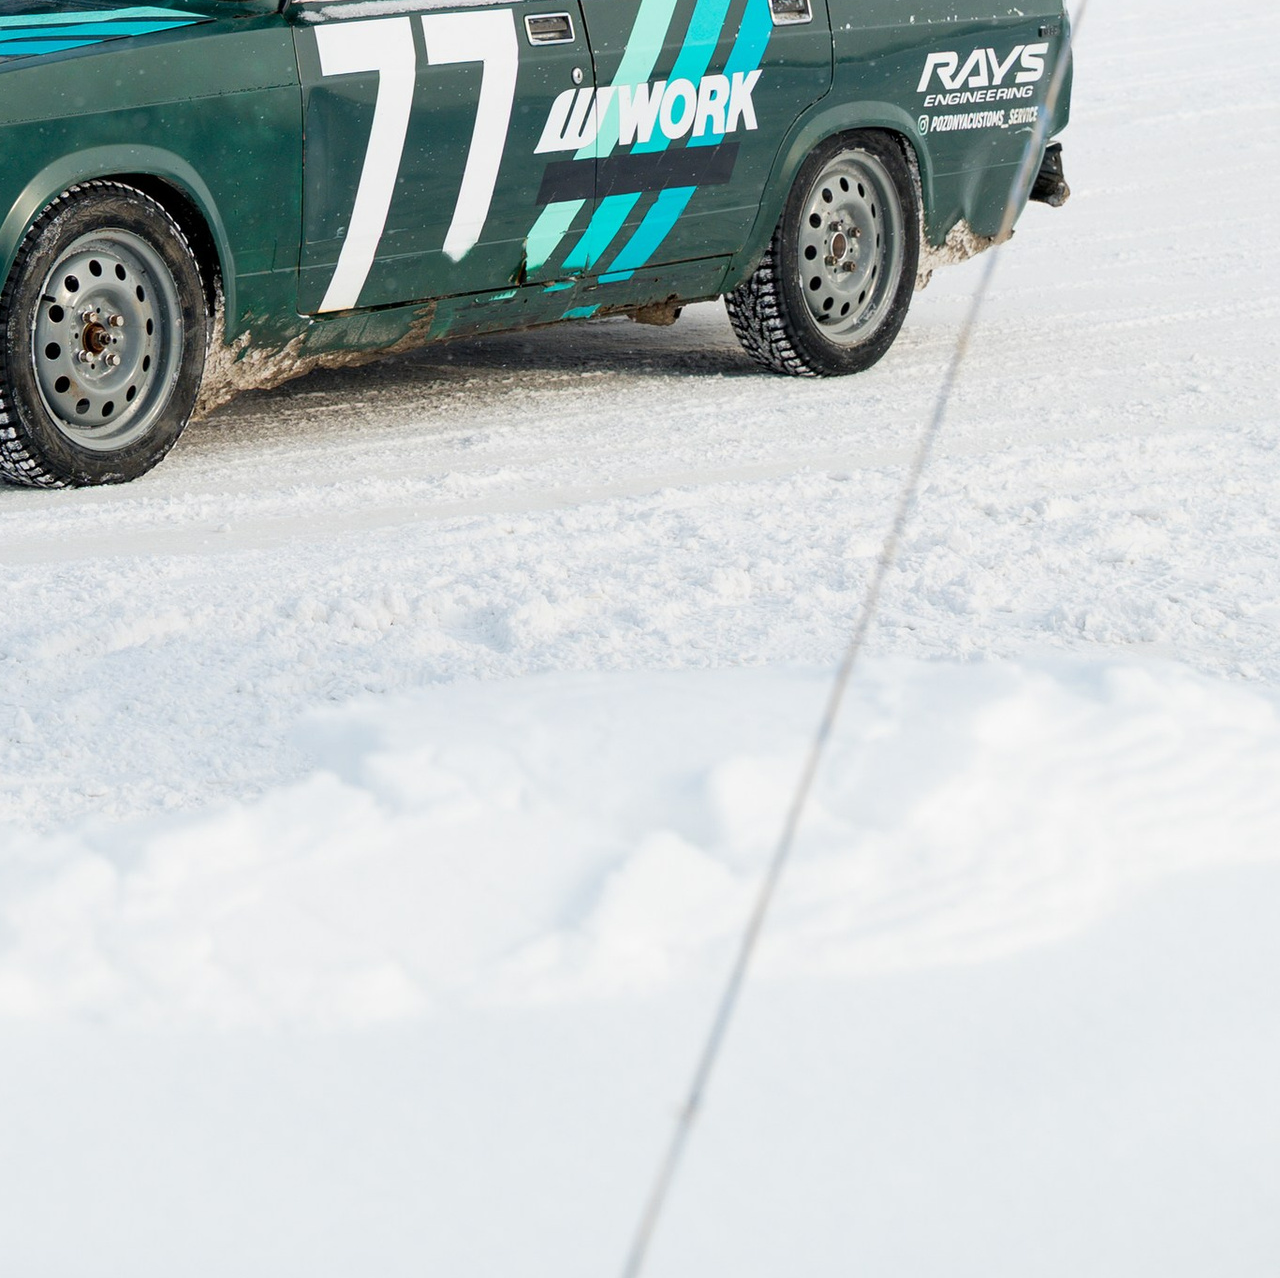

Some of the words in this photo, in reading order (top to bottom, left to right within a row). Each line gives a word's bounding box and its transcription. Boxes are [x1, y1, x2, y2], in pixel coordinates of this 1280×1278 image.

[916, 41, 1049, 93] RAYS
[923, 85, 1034, 107] ENGINEERING
[313, 7, 519, 314] 77
